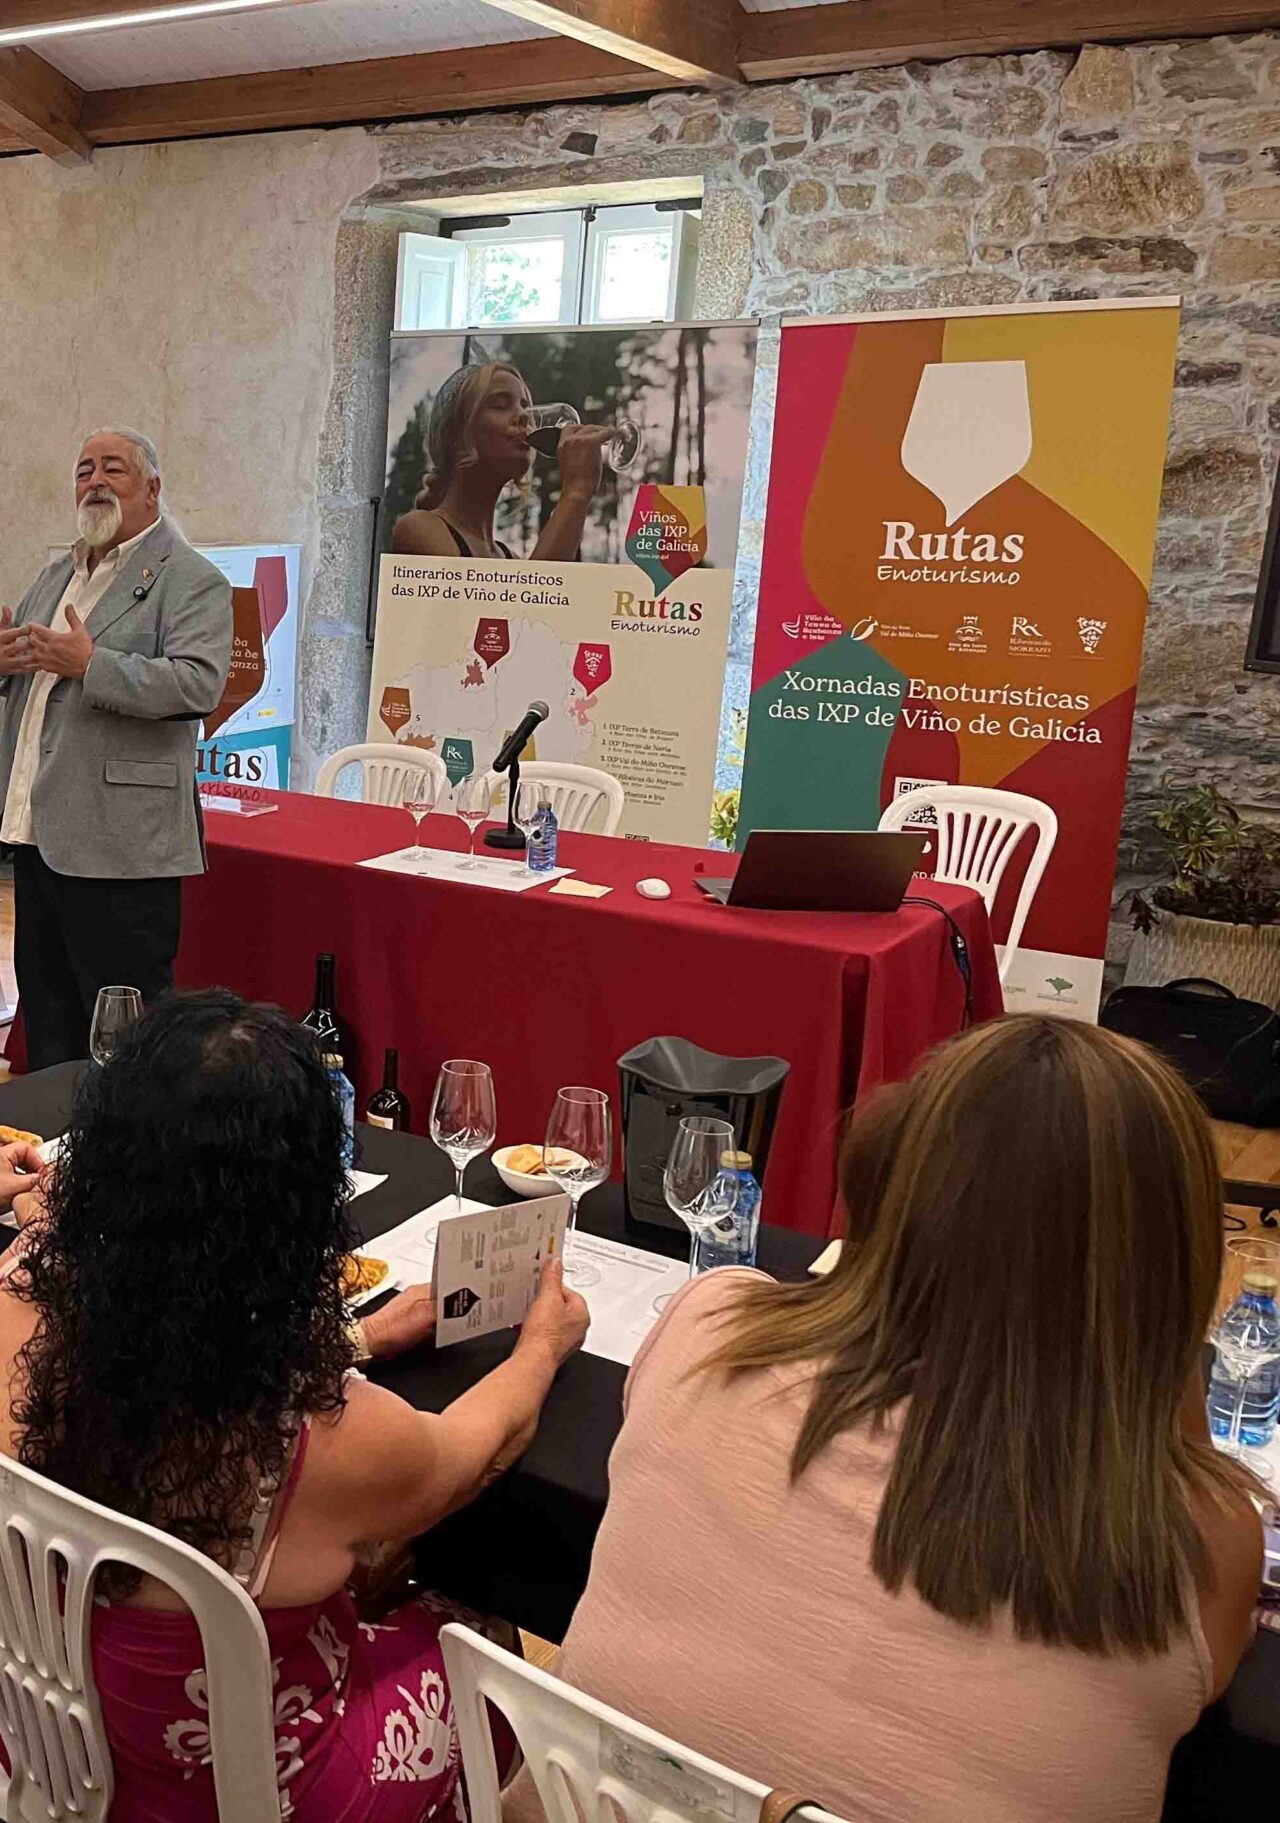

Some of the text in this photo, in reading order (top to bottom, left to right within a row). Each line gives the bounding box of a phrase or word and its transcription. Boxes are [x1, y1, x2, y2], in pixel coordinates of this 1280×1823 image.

[640, 511, 676, 523] Viños
[637, 525, 687, 538] das IXP
[636, 538, 699, 552] de Galicia
[878, 521, 1025, 563] Rutas
[392, 566, 563, 586] Itinerarios Enoturísticos
[877, 565, 1020, 585] Enoturismo
[391, 584, 570, 606] das IXP de Viño de Galicia
[612, 590, 702, 621] Rutas
[611, 620, 700, 636] Enoturismo
[782, 670, 1090, 710] Xornadas Enoturísticas
[768, 699, 1103, 744] das IXP de Viño de Galicia
